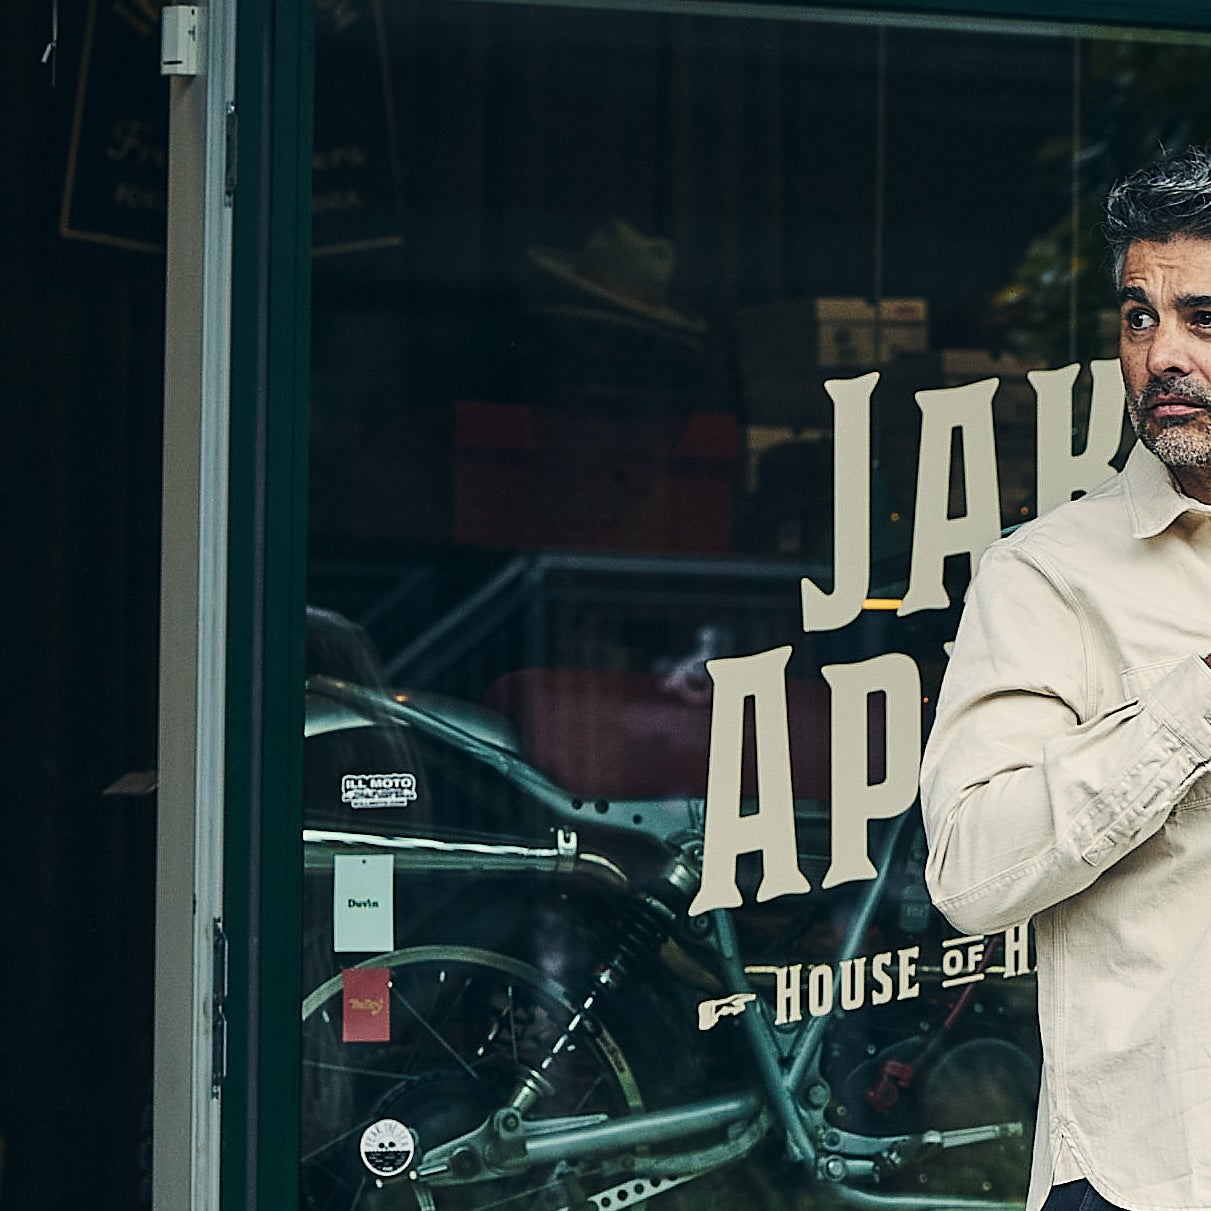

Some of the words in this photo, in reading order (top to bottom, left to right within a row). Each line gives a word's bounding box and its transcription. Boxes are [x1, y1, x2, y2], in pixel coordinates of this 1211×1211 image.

[345, 779, 367, 790] ILL
[369, 777, 412, 789] MOTO
[689, 644, 953, 918] AP
[347, 898, 379, 909] Duvin
[774, 946, 920, 1026] HOUSE
[941, 942, 985, 978] OF
[1003, 923, 1038, 978] H
